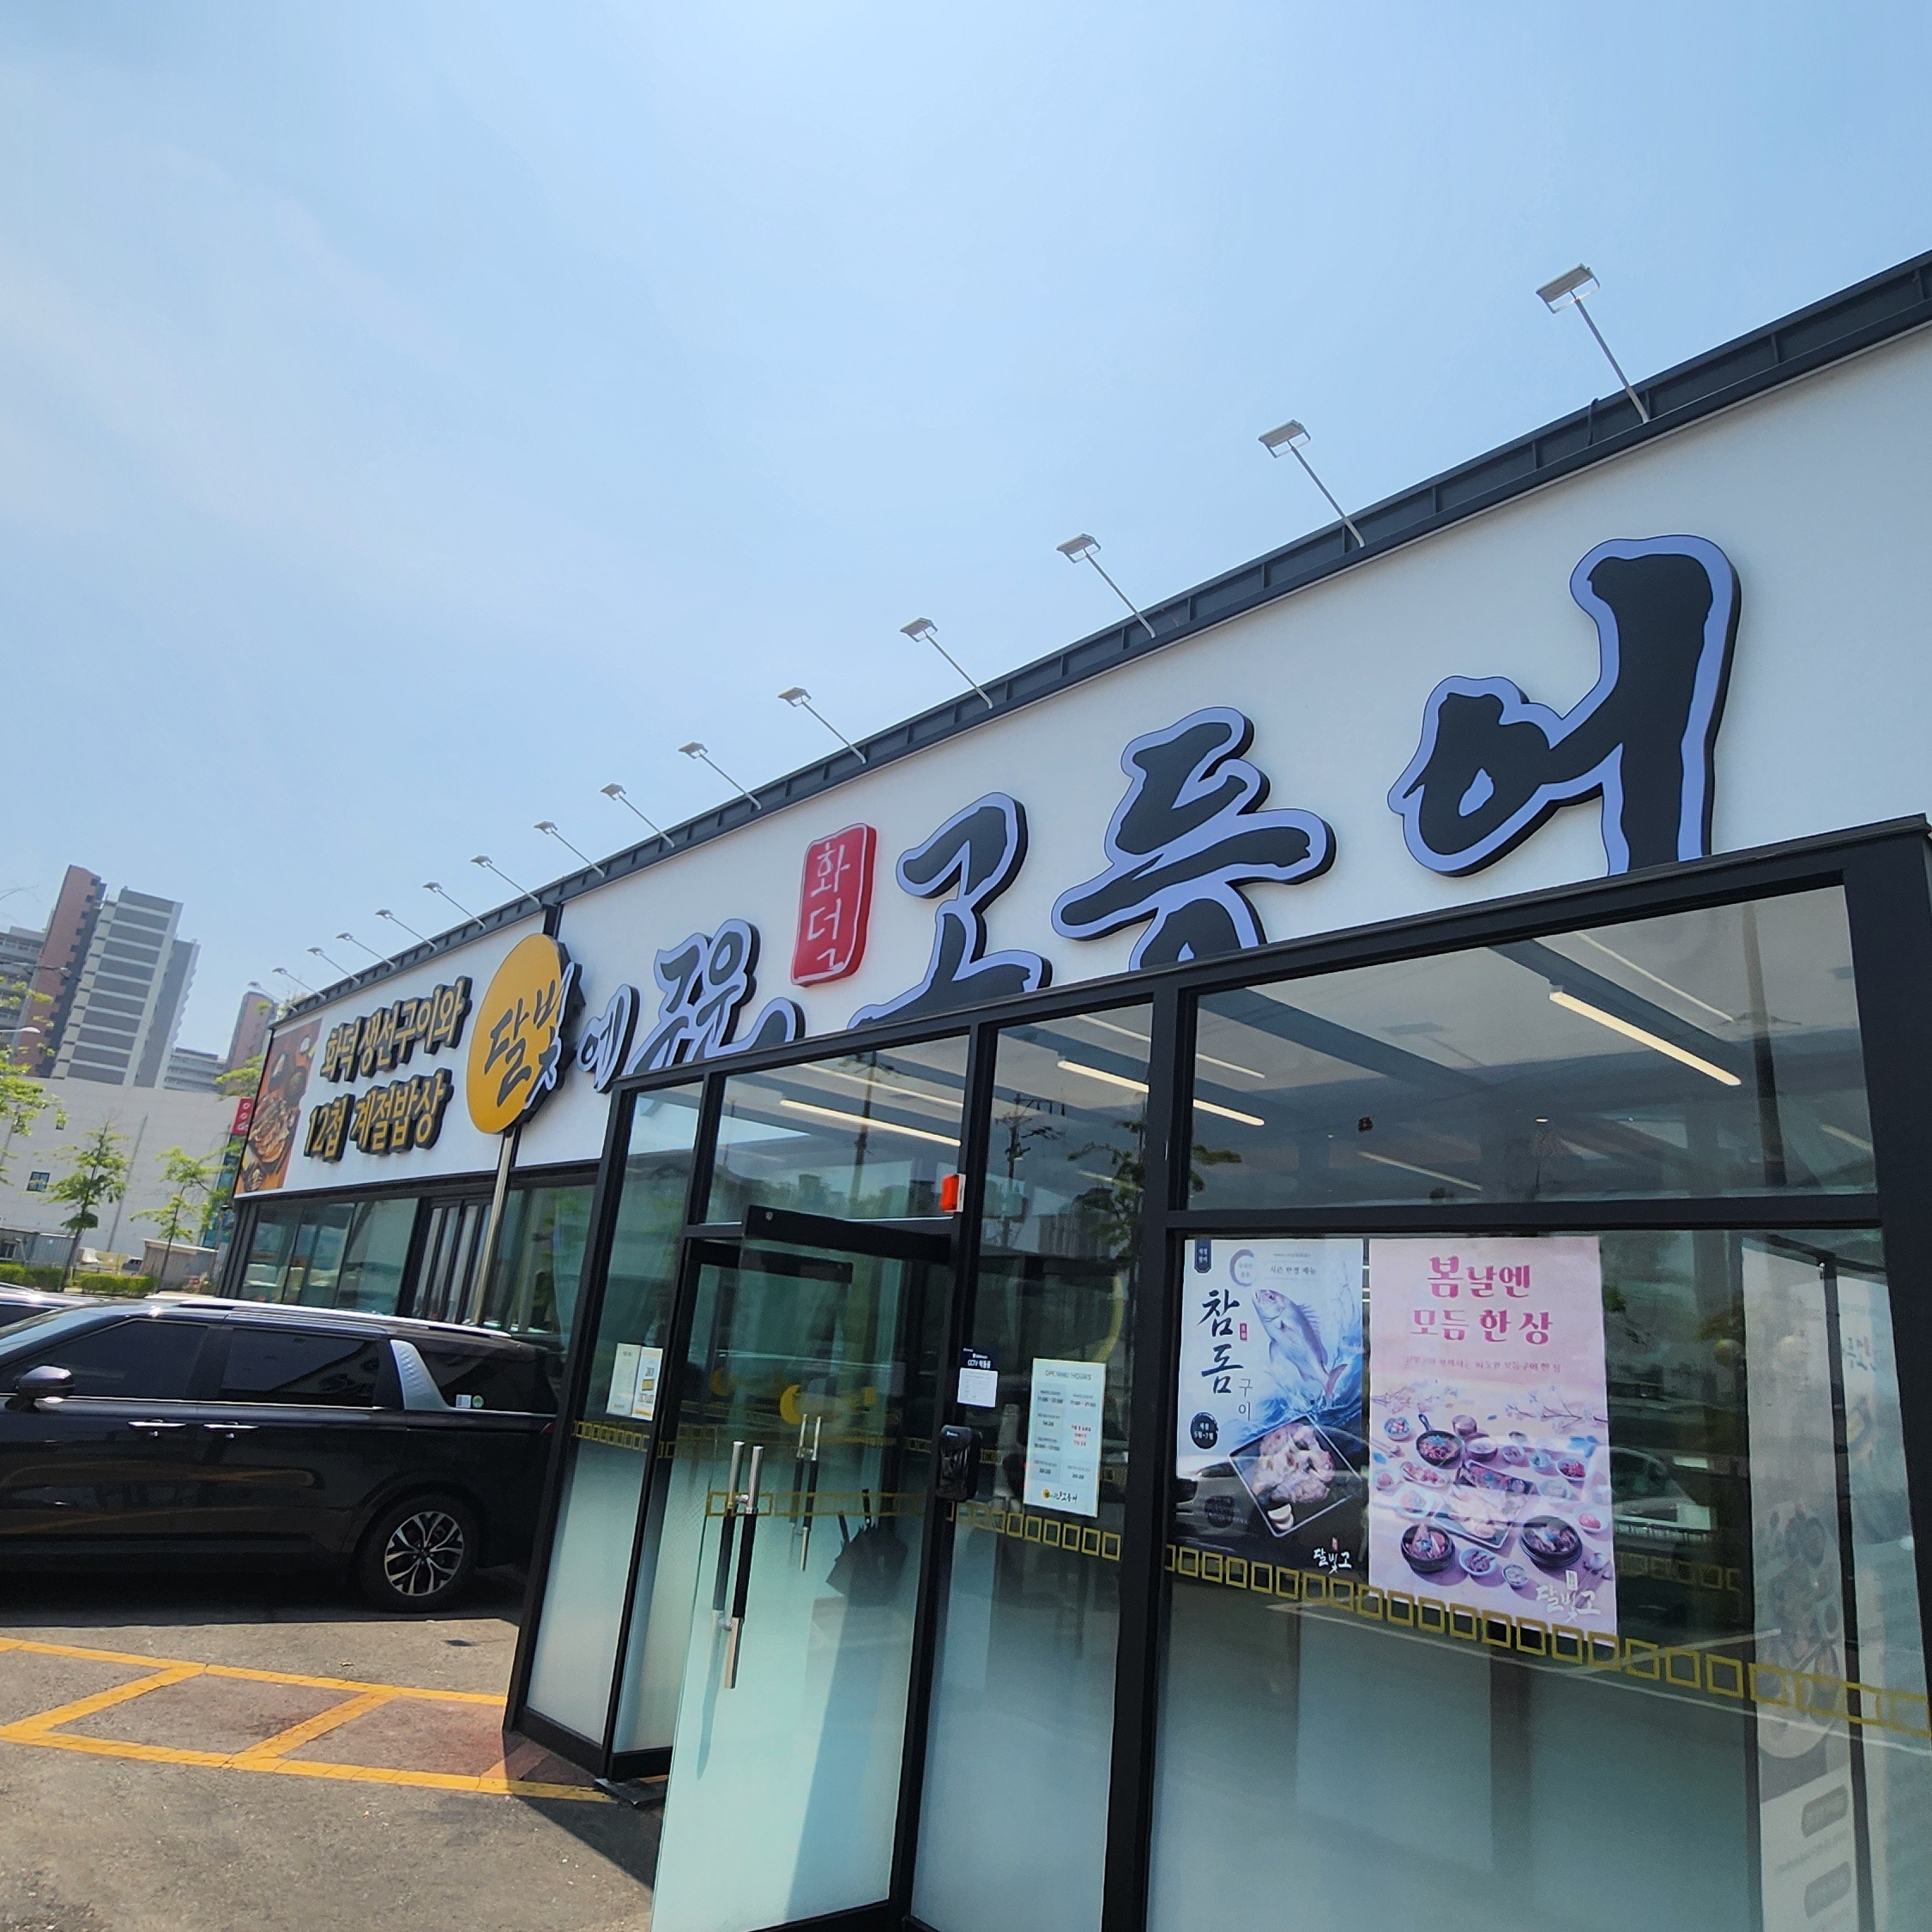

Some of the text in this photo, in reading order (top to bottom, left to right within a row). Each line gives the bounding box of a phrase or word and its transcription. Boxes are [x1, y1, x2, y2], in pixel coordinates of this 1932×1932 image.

[806, 842, 850, 971] 화덕
[304, 1067, 454, 1162] 12첩 계절밥상
[1427, 1255, 1531, 1299] 봄날엔
[1410, 1309, 1470, 1342] 모듬
[1070, 1372, 1092, 1380] HOURS
